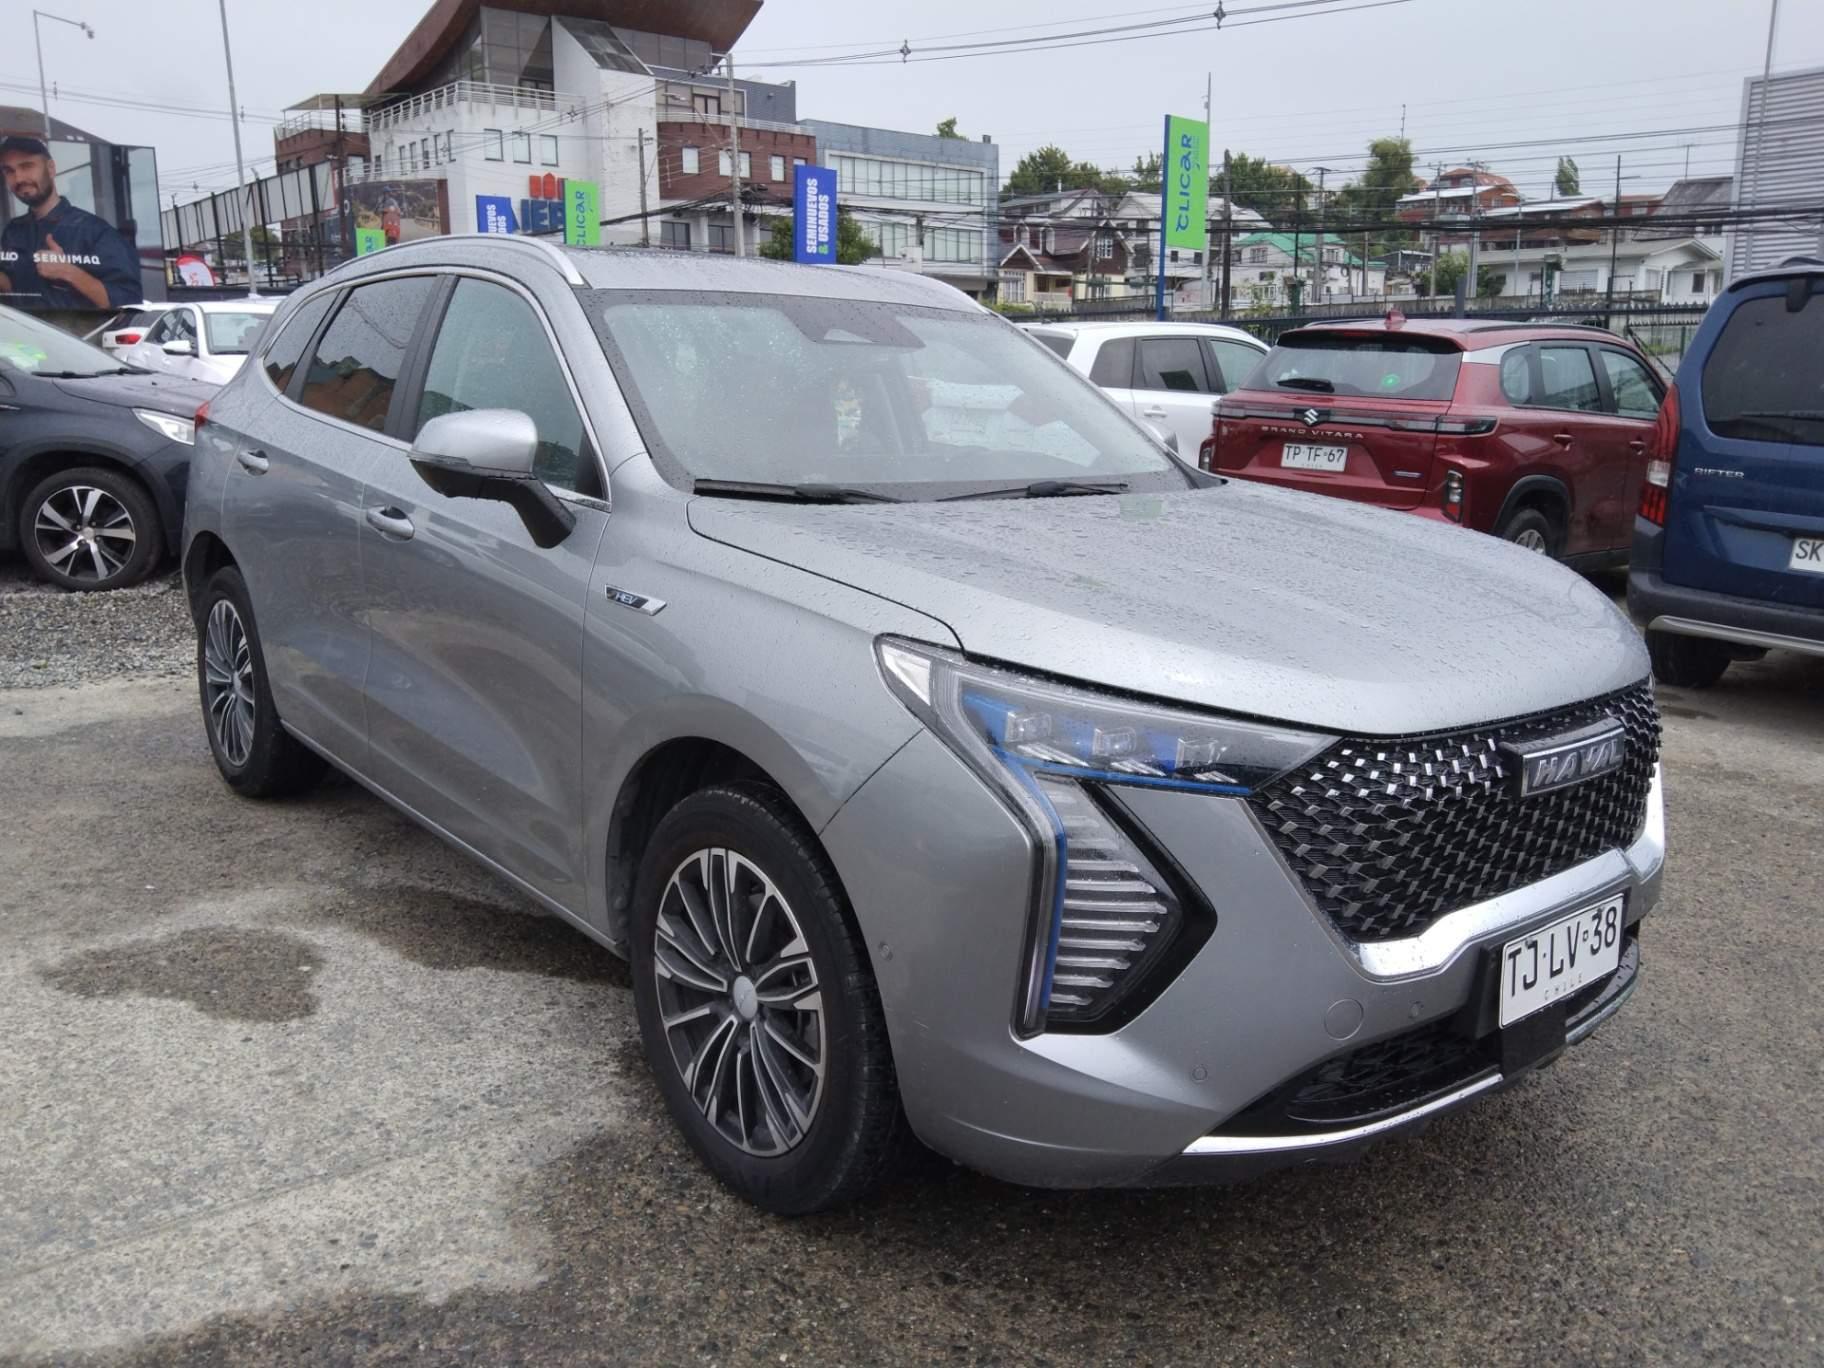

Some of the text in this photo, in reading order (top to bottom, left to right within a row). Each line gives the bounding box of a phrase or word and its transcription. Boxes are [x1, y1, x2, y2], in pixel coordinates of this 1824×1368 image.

[806, 177, 818, 254] SEMINUEVOS
[818, 194, 829, 242] USADOS
[33, 253, 101, 265] SERVIMAQ
[1312, 430, 1364, 439] VITARA
[1694, 467, 1745, 479] RIFTER
[1532, 738, 1622, 787] HAVAL
